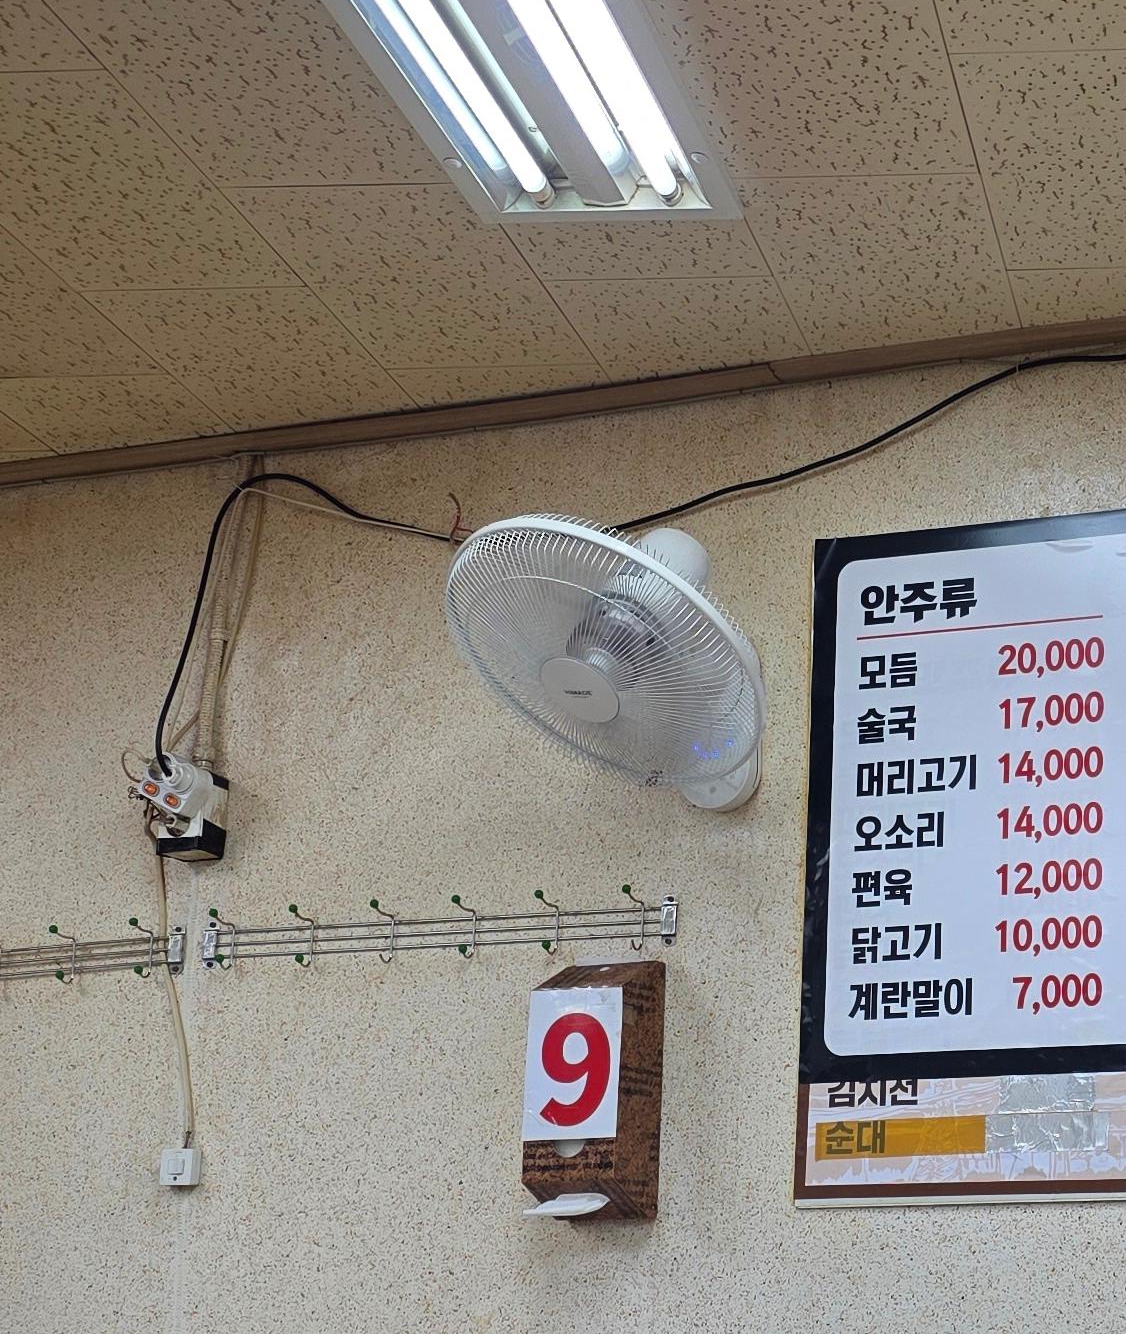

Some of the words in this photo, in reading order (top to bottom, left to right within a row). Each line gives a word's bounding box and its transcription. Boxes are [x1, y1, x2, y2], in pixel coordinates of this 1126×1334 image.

[860, 577, 978, 626] 안주류
[858, 651, 918, 690] 모듬
[997, 637, 1105, 679] 20,000
[857, 705, 917, 745] 술국
[998, 690, 1105, 732] 17,000
[856, 754, 977, 798] 머리고기
[997, 746, 1104, 788] 14,000
[853, 810, 945, 853] 오소리
[996, 801, 1104, 843] 14,000
[851, 868, 913, 908] 편육
[996, 858, 1103, 899] 12,000
[851, 922, 942, 965] 닭고기
[995, 915, 1102, 958] 10,000
[847, 977, 973, 1021] 계란말이
[1012, 973, 1103, 1014] 7,000
[539, 1012, 611, 1127] 9
[825, 1120, 886, 1154] 순대
